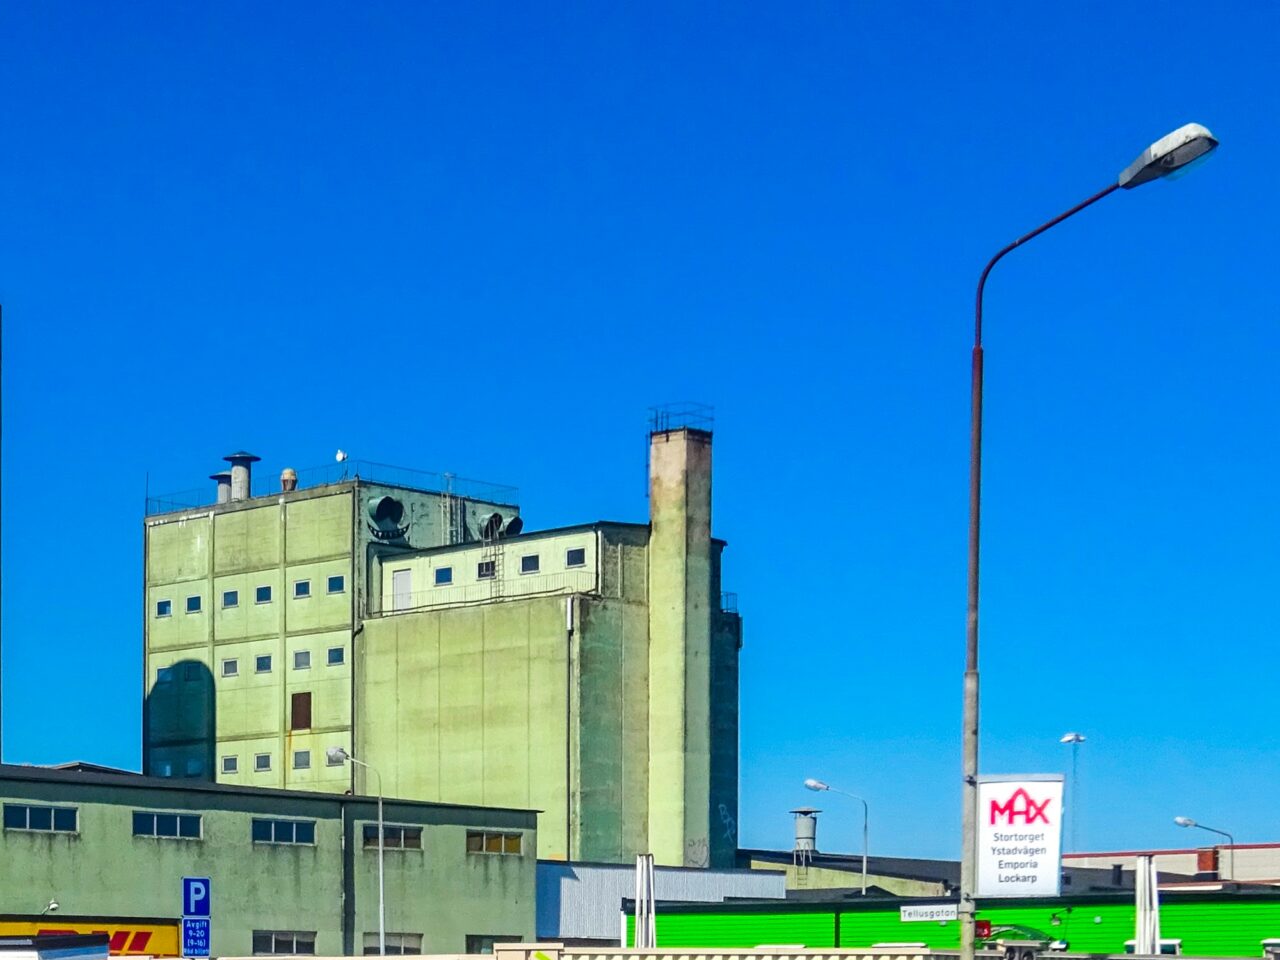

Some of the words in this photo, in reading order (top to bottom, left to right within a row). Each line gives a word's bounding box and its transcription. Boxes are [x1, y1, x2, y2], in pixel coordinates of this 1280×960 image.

[989, 786, 1052, 826] MAX
[993, 832, 1046, 843] Stortorget
[990, 846, 1047, 856] Ystadvägen
[998, 860, 1039, 870] Emporia
[998, 873, 1038, 884] Lockarp
[189, 881, 206, 913] P
[902, 908, 957, 920] Tellusgatan
[186, 920, 208, 930] Avgift
[188, 930, 206, 938] 9-20
[187, 938, 207, 947] (9-16)
